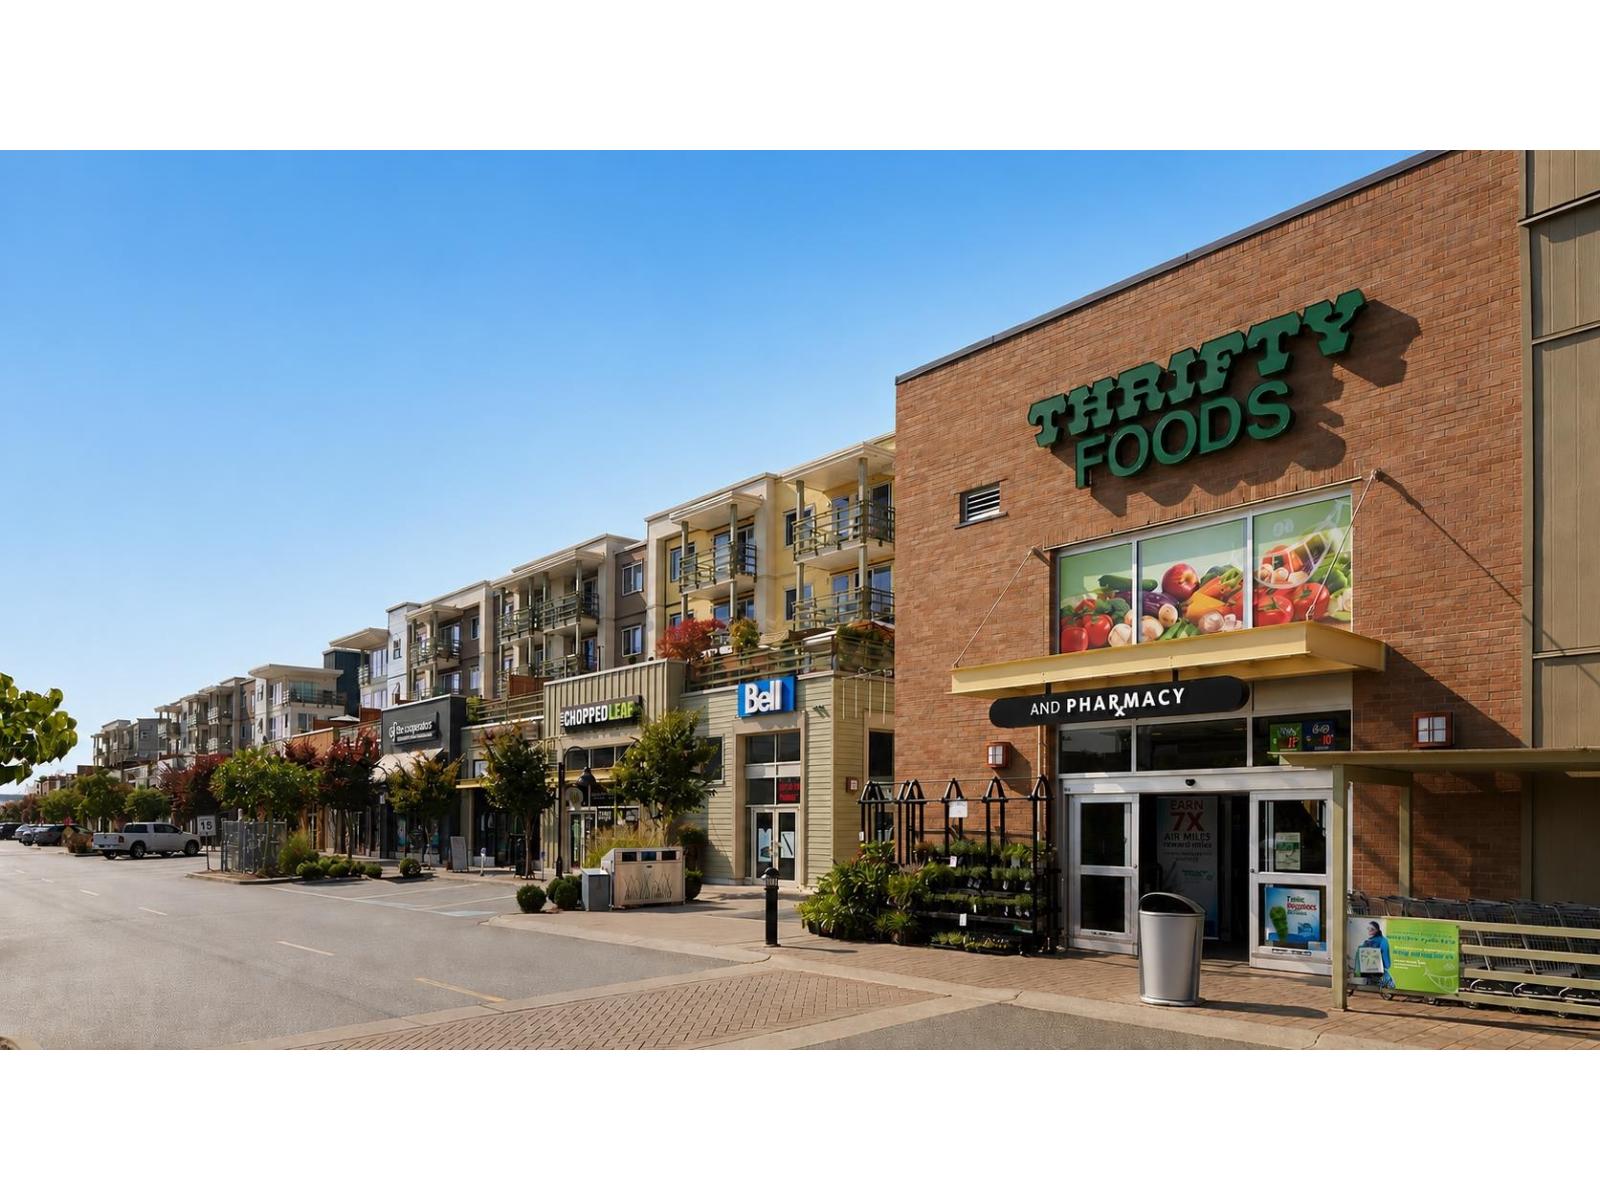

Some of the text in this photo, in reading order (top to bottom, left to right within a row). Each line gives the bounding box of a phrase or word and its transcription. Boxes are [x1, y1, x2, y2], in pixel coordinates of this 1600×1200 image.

[1028, 287, 1367, 448] THRIFTY
[1075, 380, 1294, 489] FOODS
[745, 679, 783, 714] Bell
[1030, 688, 1185, 716] AND PHARMACY
[564, 705, 608, 727] CHOPPED
[1171, 799, 1204, 810] EARN
[1169, 811, 1205, 832] 7X
[1164, 832, 1211, 841] AIR MILES
